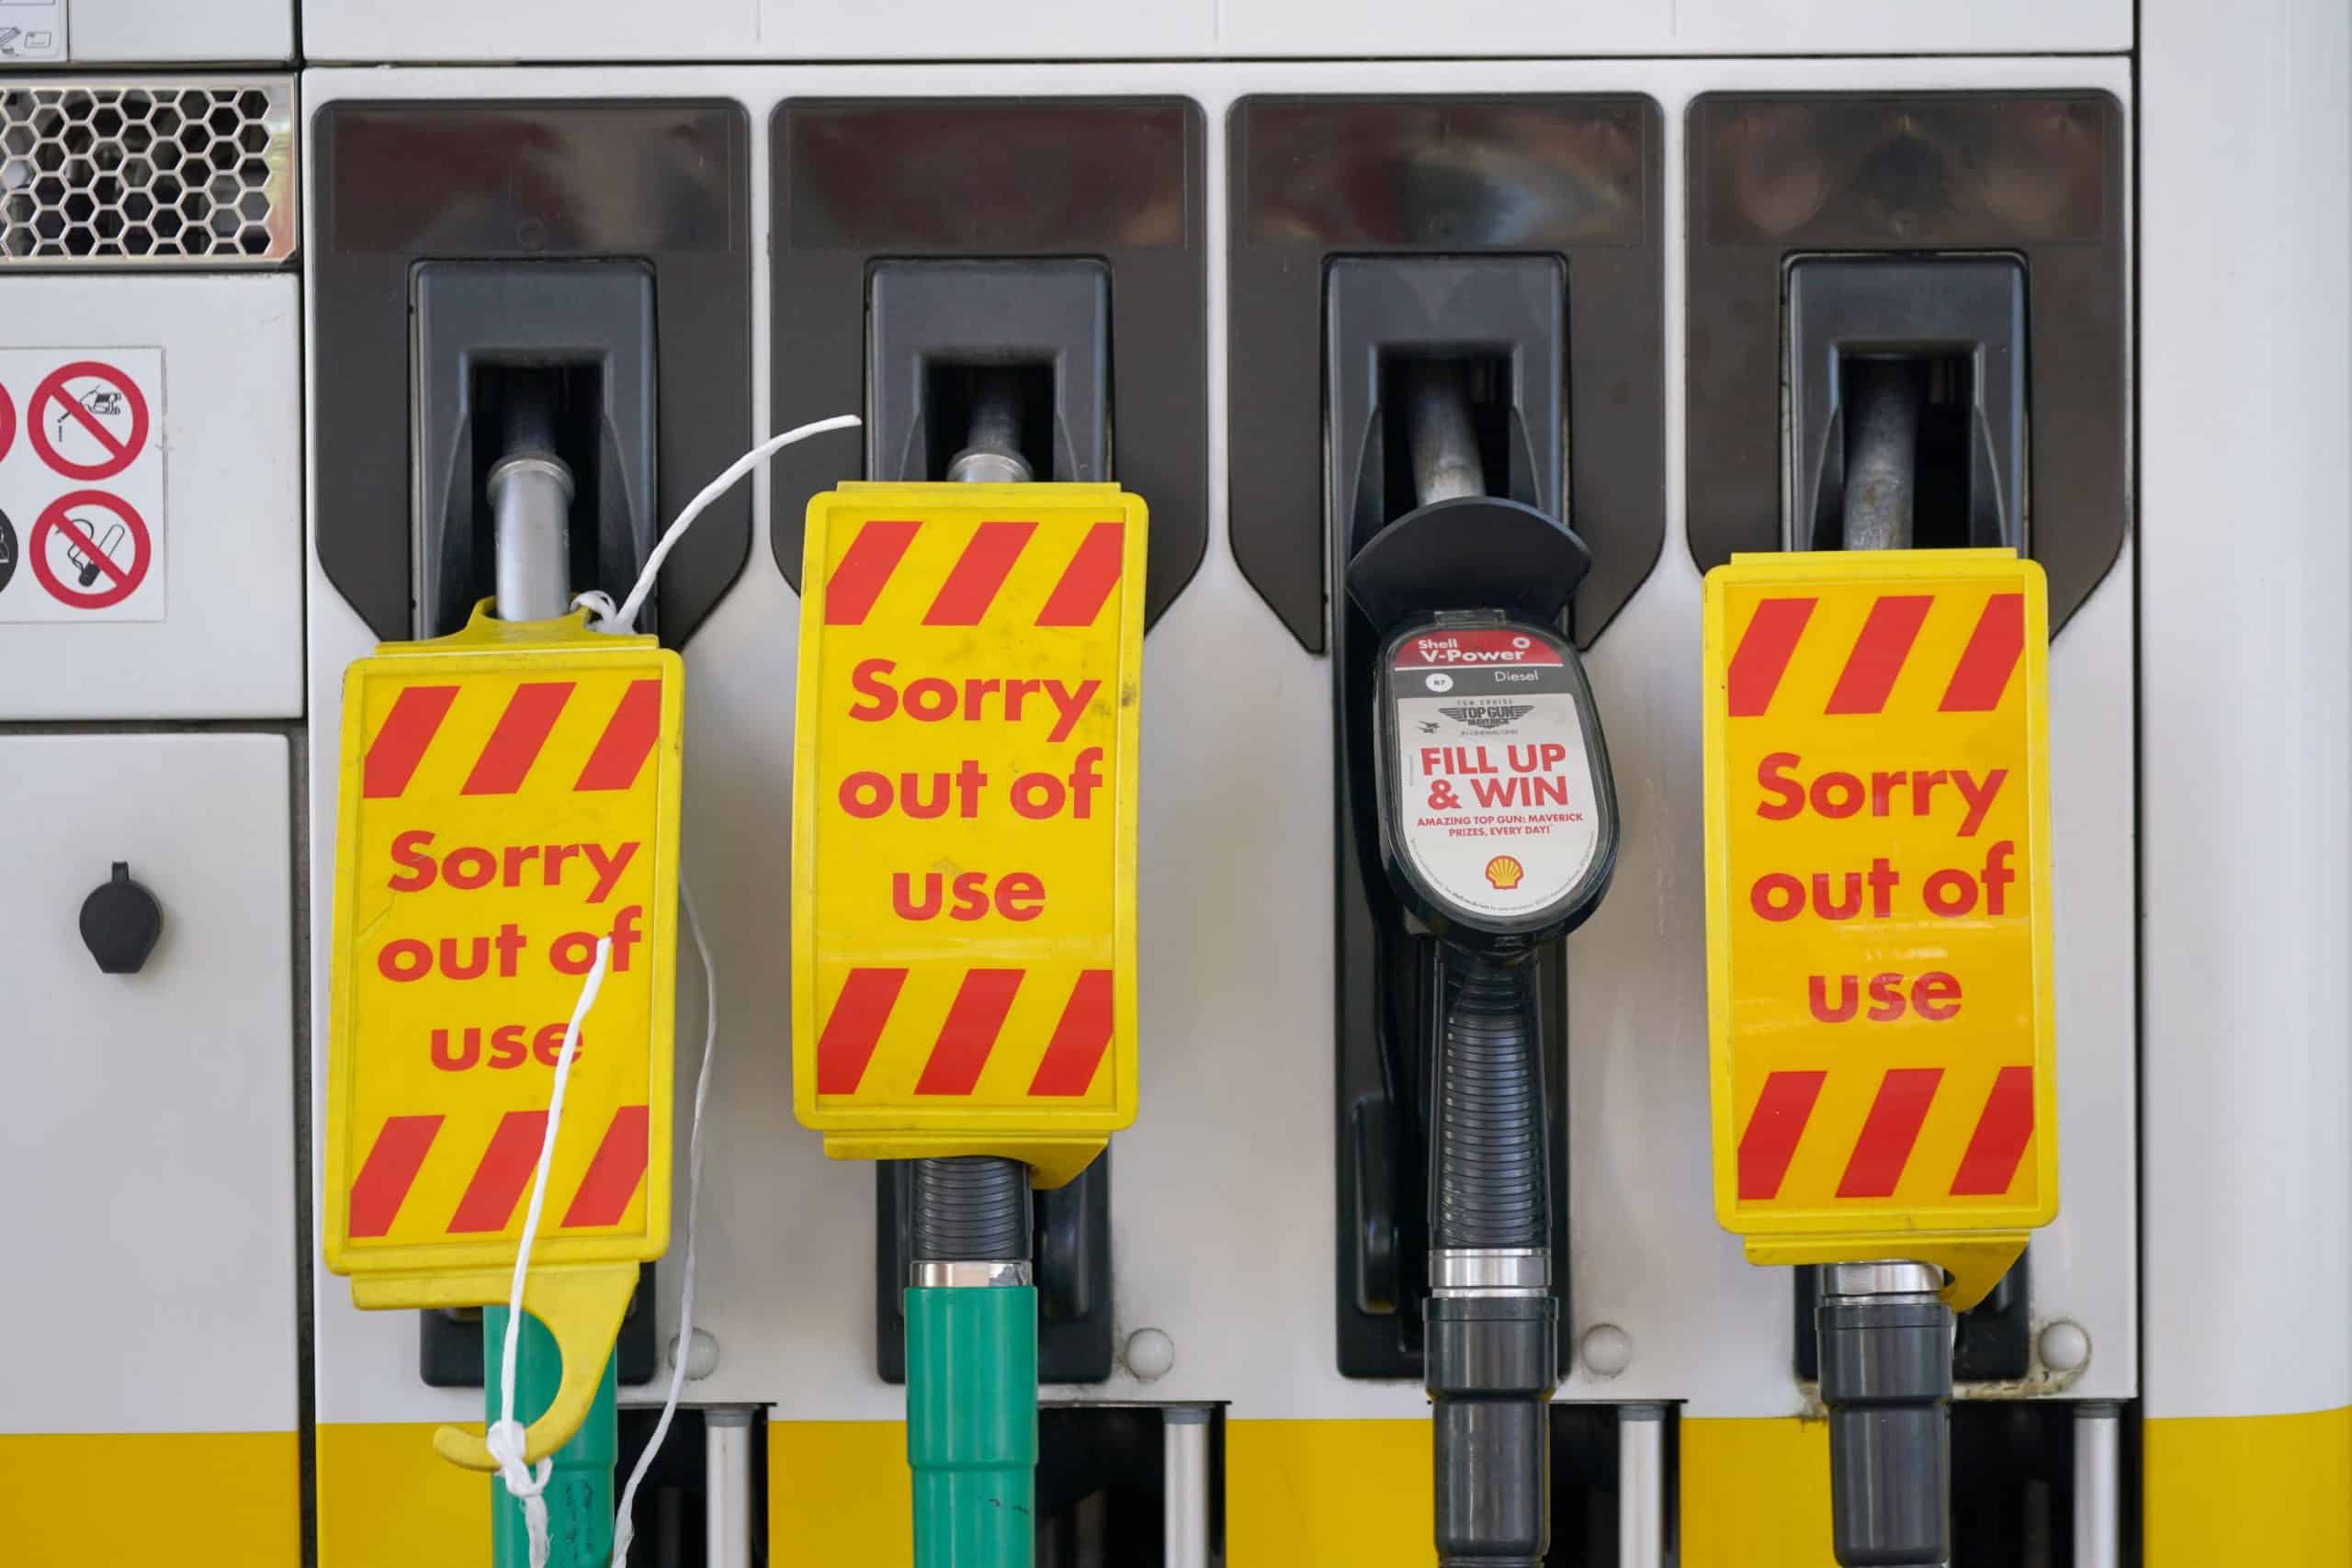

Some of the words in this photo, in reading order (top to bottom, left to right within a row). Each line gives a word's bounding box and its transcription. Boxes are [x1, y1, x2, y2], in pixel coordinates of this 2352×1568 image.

[1418, 637, 1459, 649] Shell
[1419, 649, 1525, 662] V-Power
[848, 658, 1102, 743] Sorry
[1494, 669, 1539, 682] Diesel
[1463, 706, 1487, 719] TOP
[1487, 705, 1515, 718] GUN
[838, 760, 988, 819] out
[1010, 746, 1103, 820] of
[1419, 746, 1499, 775] FILL
[1507, 743, 1566, 773] UP
[1427, 779, 1463, 810] &
[1469, 775, 1568, 808] WIN
[1756, 751, 2009, 838] Sorry
[1417, 815, 1471, 828] AMAZING
[1474, 814, 1495, 826] TOP
[1497, 813, 1526, 824] GUN:
[1528, 812, 1583, 823] MAVERICK
[1448, 827, 1487, 838] PRIZES,
[1489, 826, 1522, 836] EVERY
[387, 829, 640, 904] Sorry
[1749, 858, 1900, 922] out
[1922, 840, 2015, 918] of
[891, 871, 1046, 922] use
[378, 923, 527, 983] out
[548, 904, 642, 976] of
[1807, 971, 1962, 1023] use
[430, 1022, 583, 1073] use
